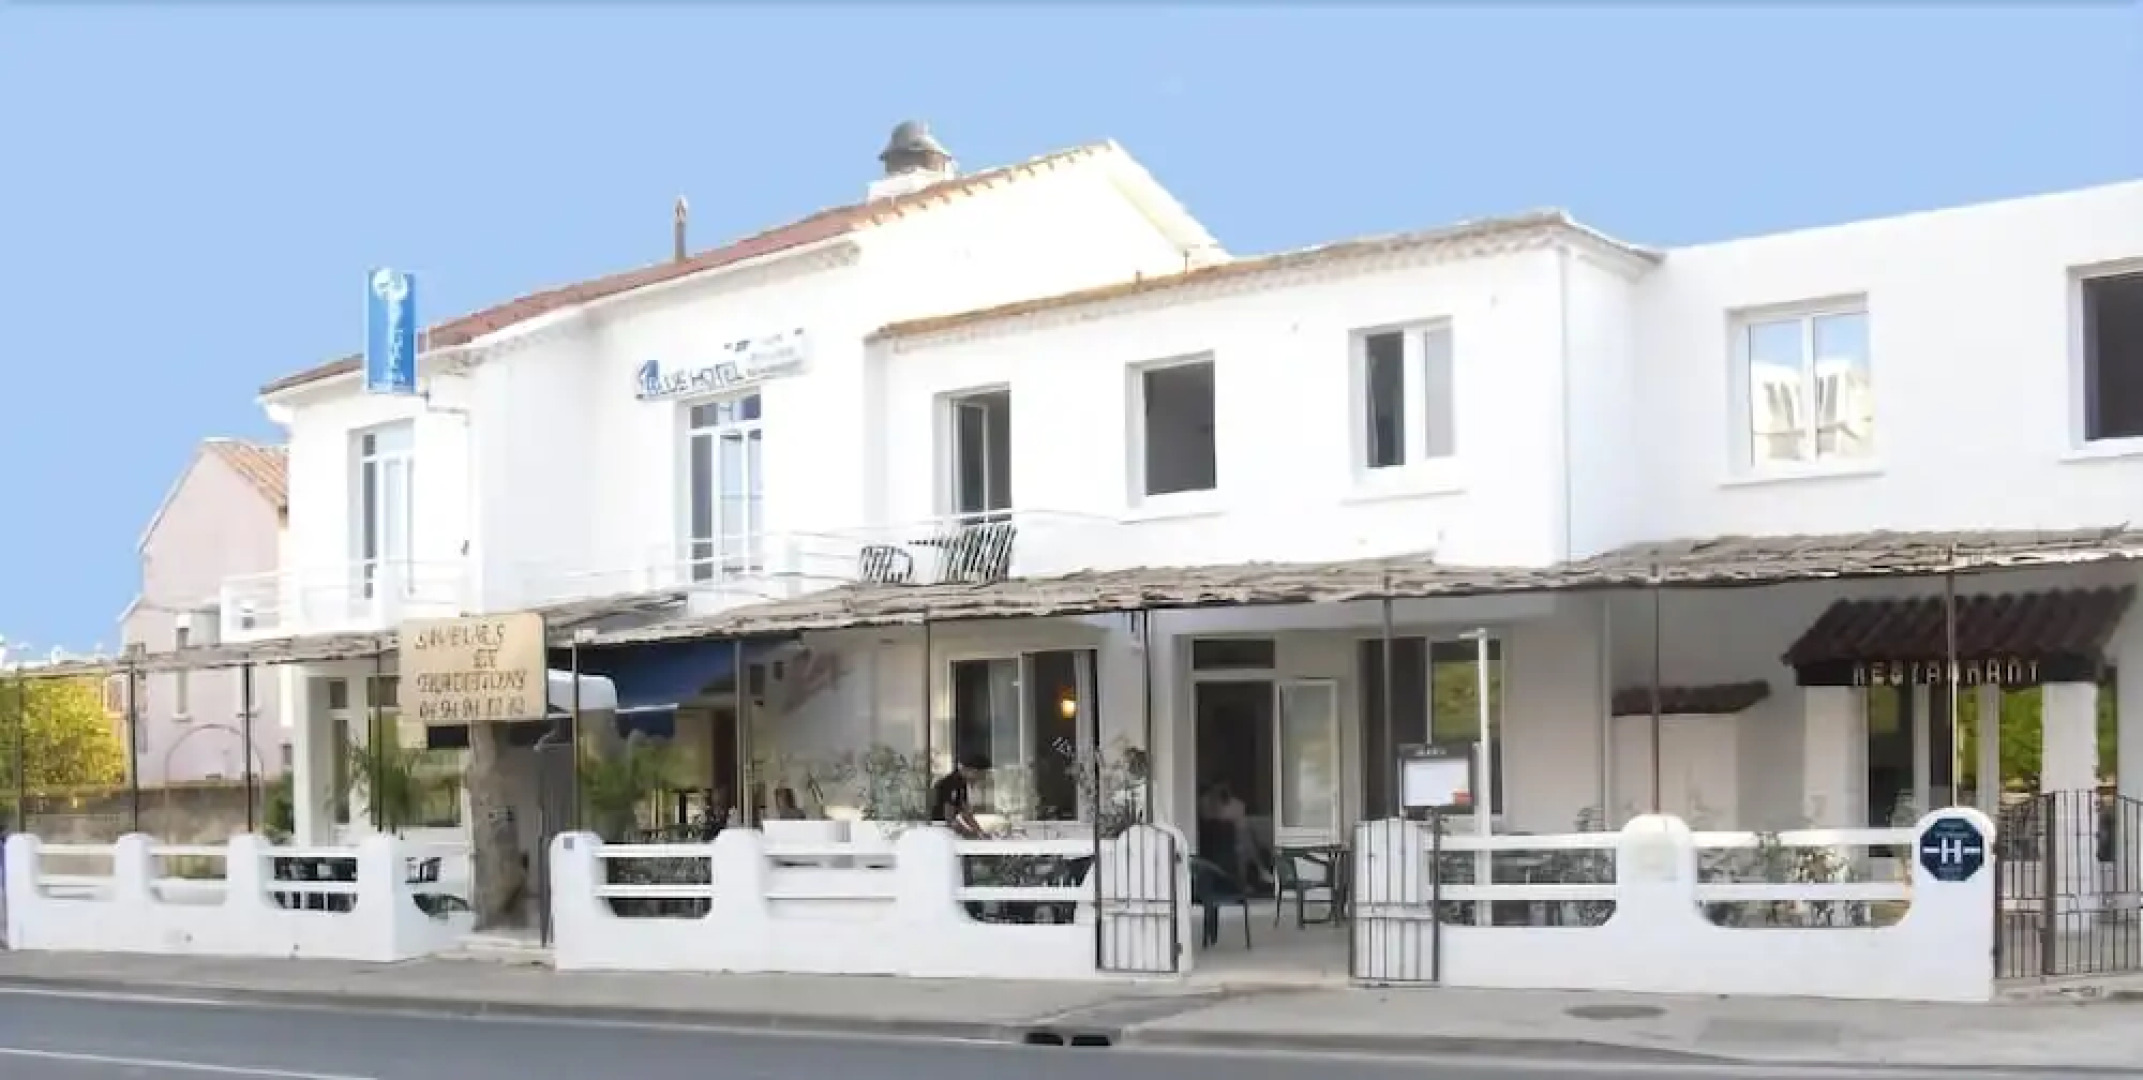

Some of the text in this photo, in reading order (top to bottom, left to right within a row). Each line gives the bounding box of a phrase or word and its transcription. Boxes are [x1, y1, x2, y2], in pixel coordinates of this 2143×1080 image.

[691, 361, 744, 389] HOTEL
[473, 648, 498, 668] ET
[1941, 838, 1962, 865] H
